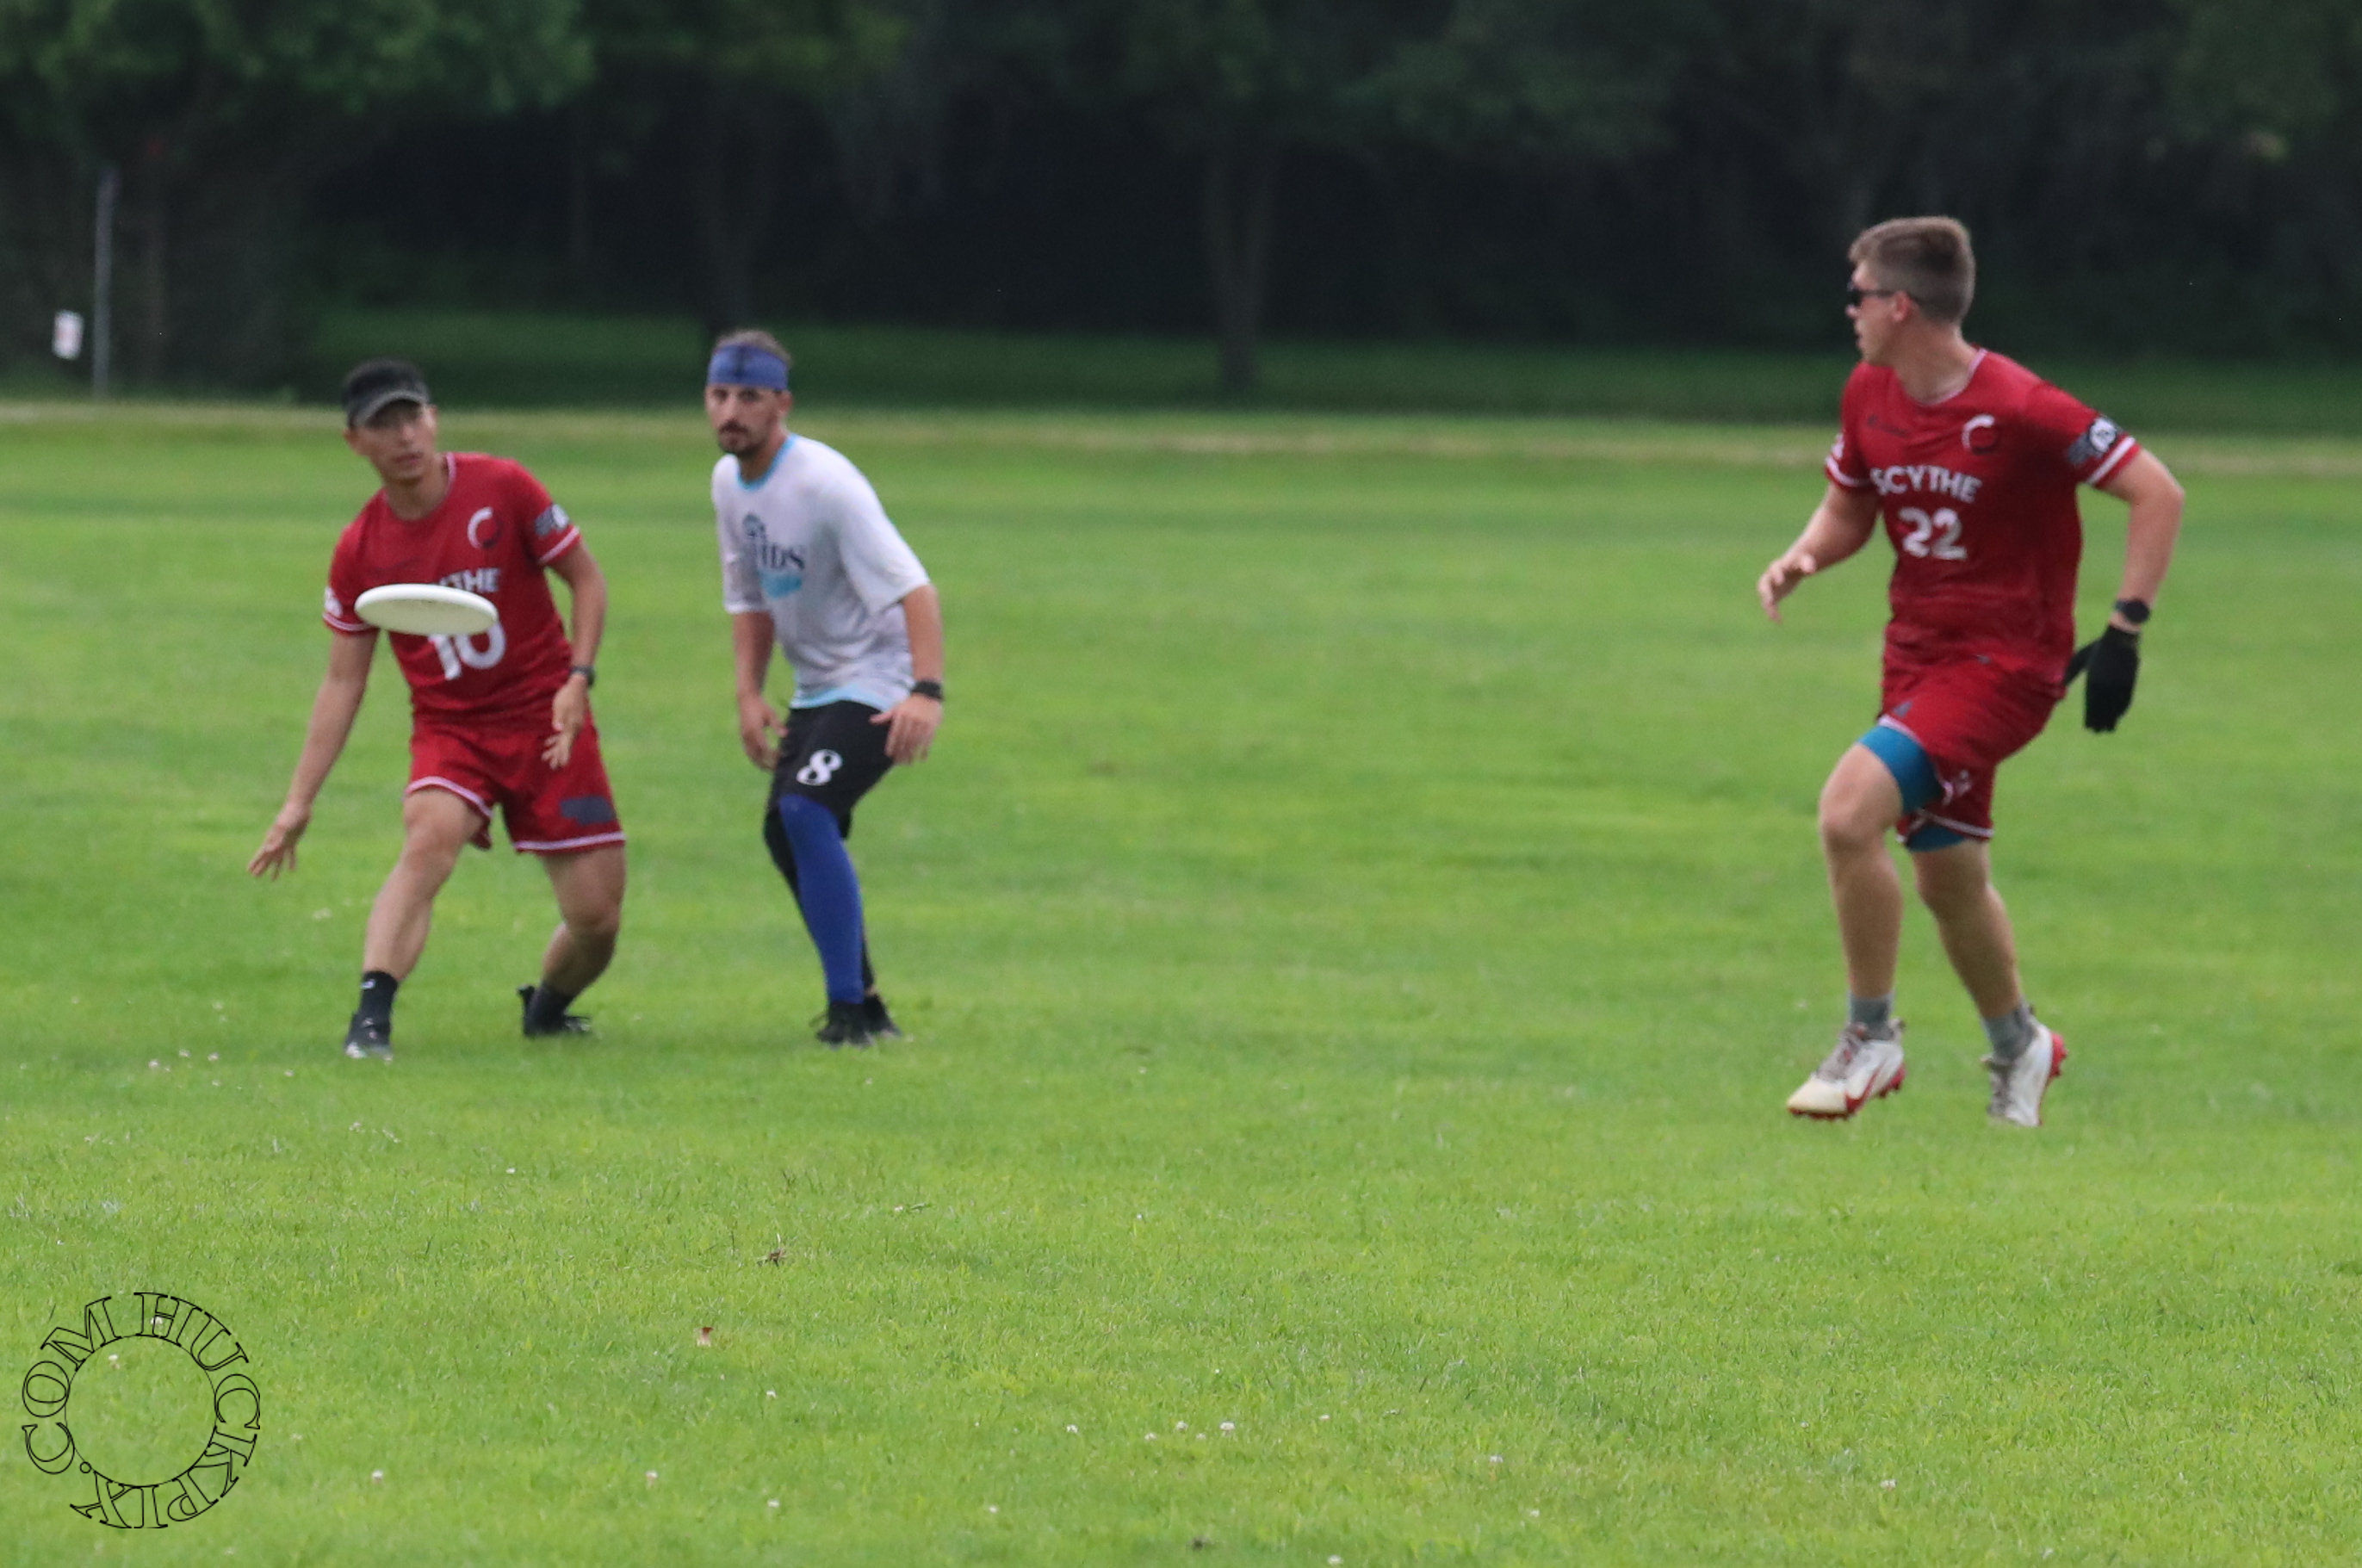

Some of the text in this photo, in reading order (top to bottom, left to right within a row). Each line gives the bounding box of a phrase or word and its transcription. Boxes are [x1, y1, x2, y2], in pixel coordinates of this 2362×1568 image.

[1869, 464, 1982, 503] SCYTHE
[1898, 506, 1968, 560] 22
[428, 622, 505, 680] 10
[796, 748, 843, 786] 8
